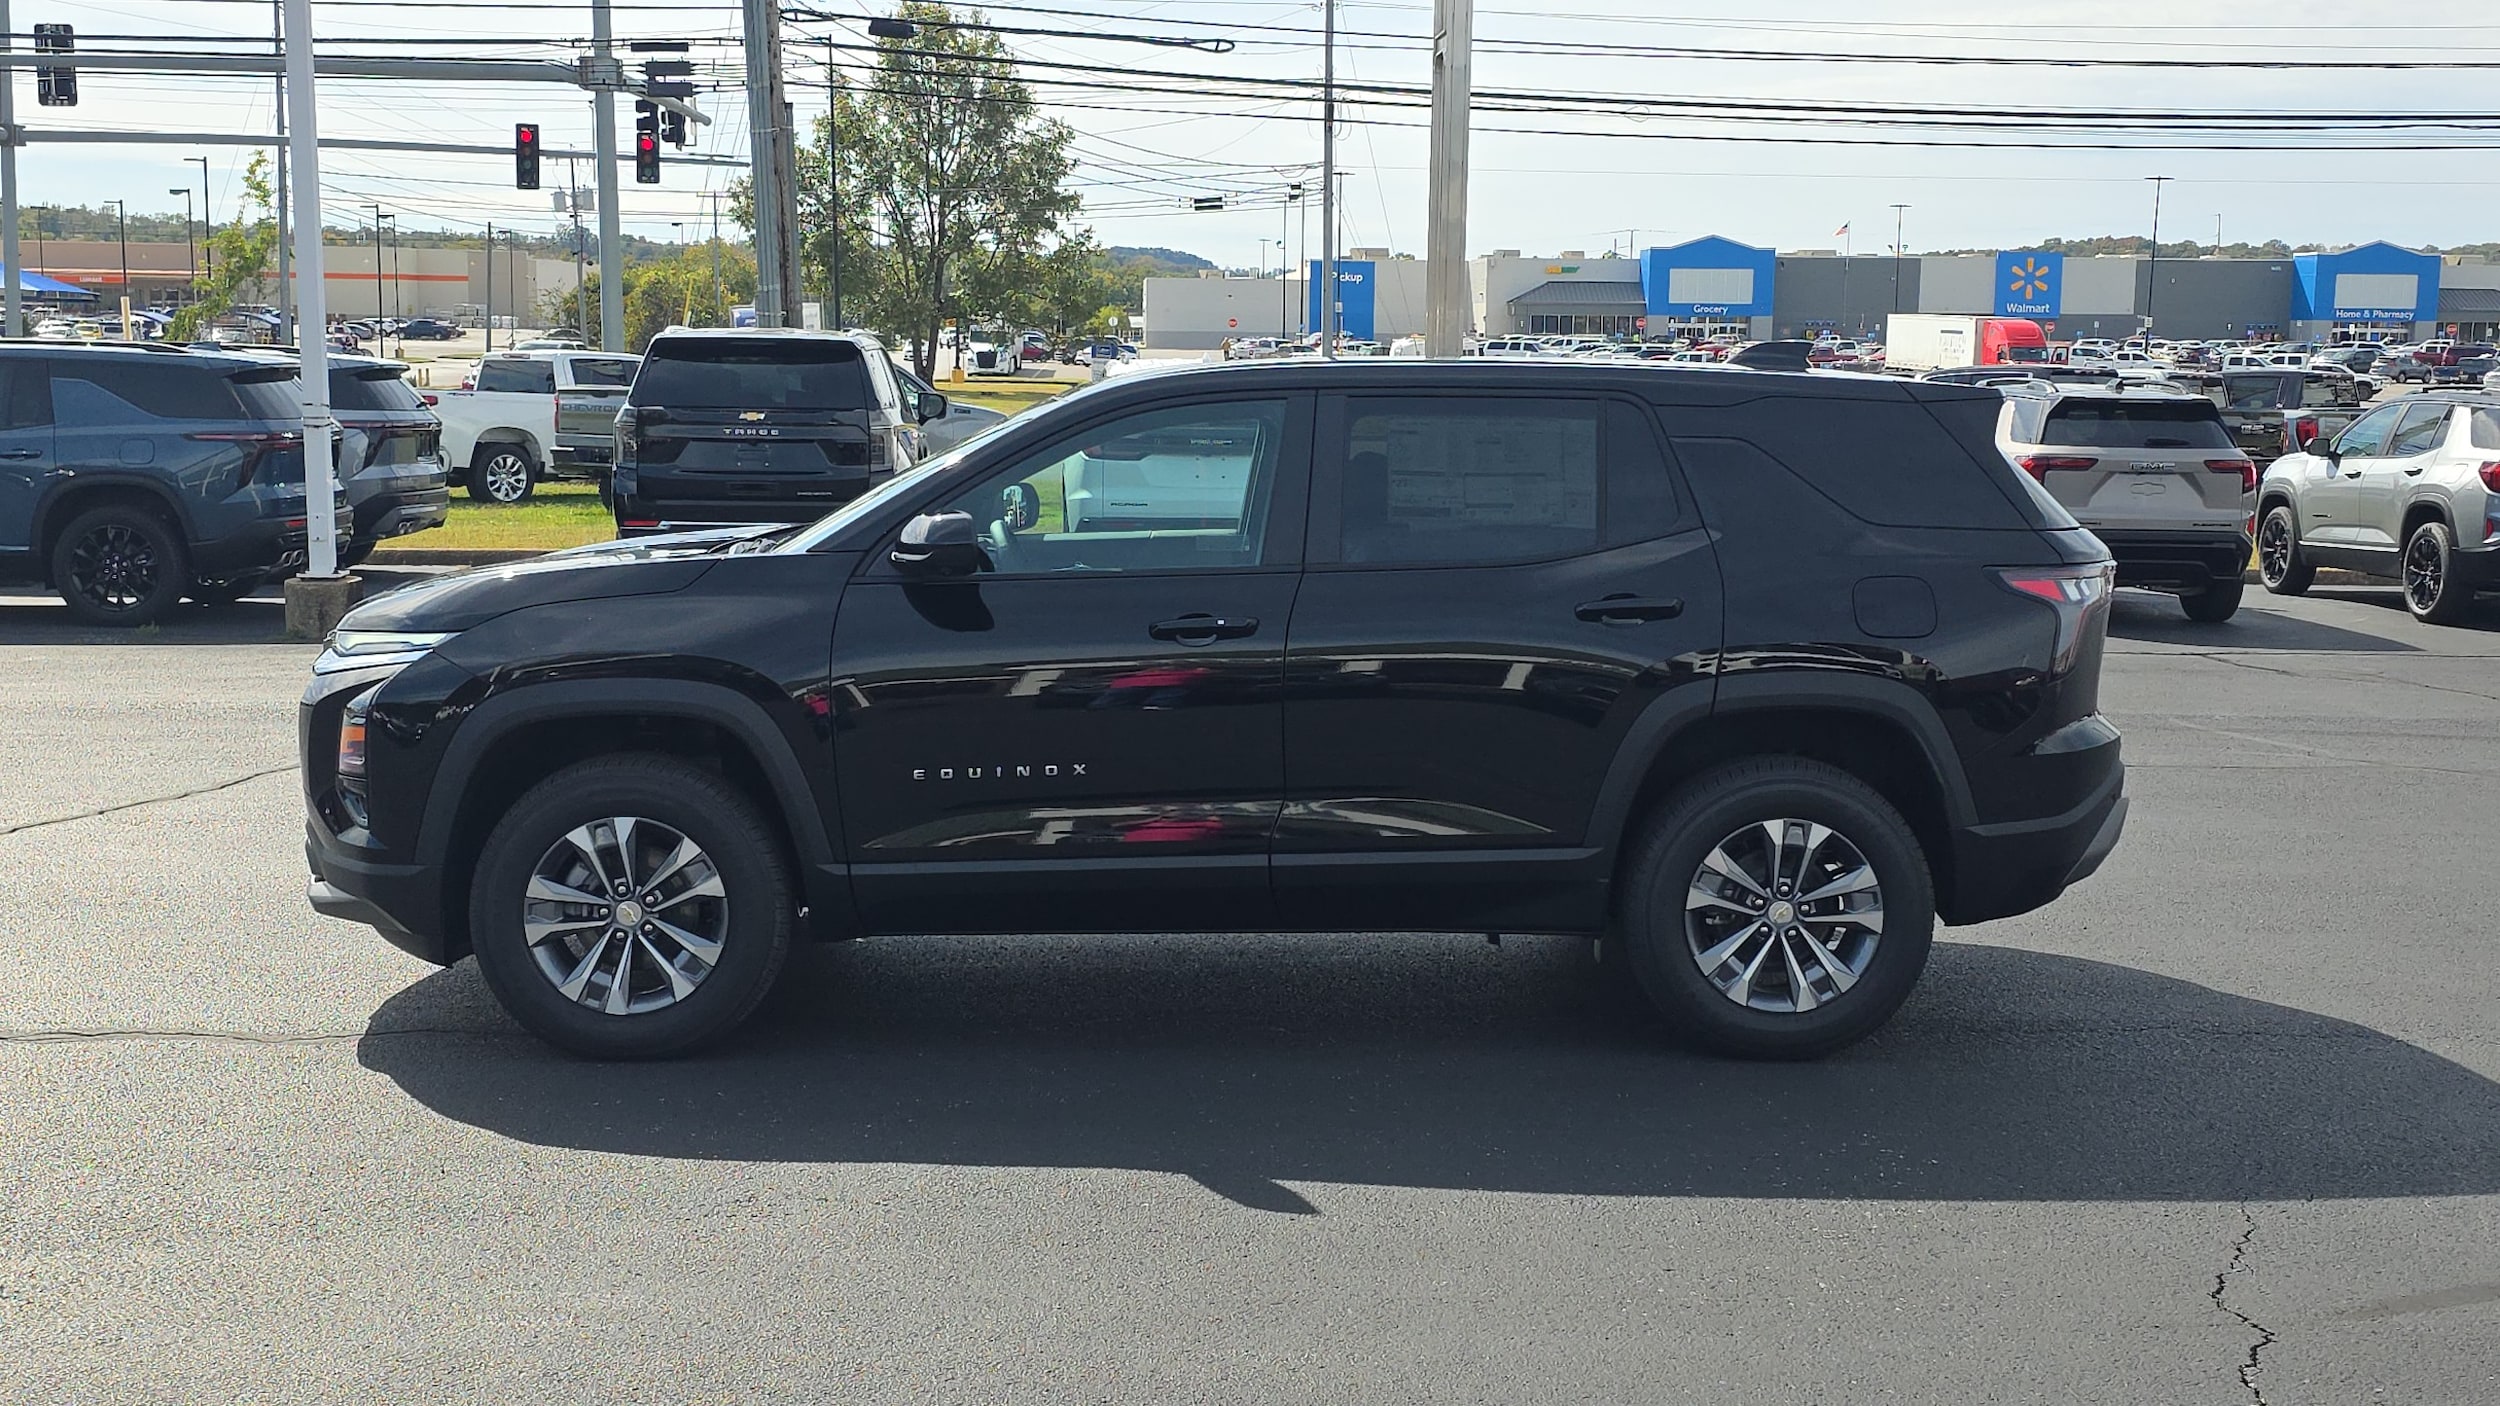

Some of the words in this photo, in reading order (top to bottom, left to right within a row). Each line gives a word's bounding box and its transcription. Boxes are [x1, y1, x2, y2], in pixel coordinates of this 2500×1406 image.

[1332, 271, 1364, 285] Pckup
[1693, 304, 1729, 316] Grocery
[2006, 302, 2050, 313] Walmart
[2335, 309, 2361, 319] Home
[2363, 309, 2371, 319] &
[2372, 309, 2415, 321] Pharmacy
[561, 403, 620, 413] CHEVROL
[2129, 462, 2177, 473] GMC
[912, 763, 1087, 781] EQUINOX
